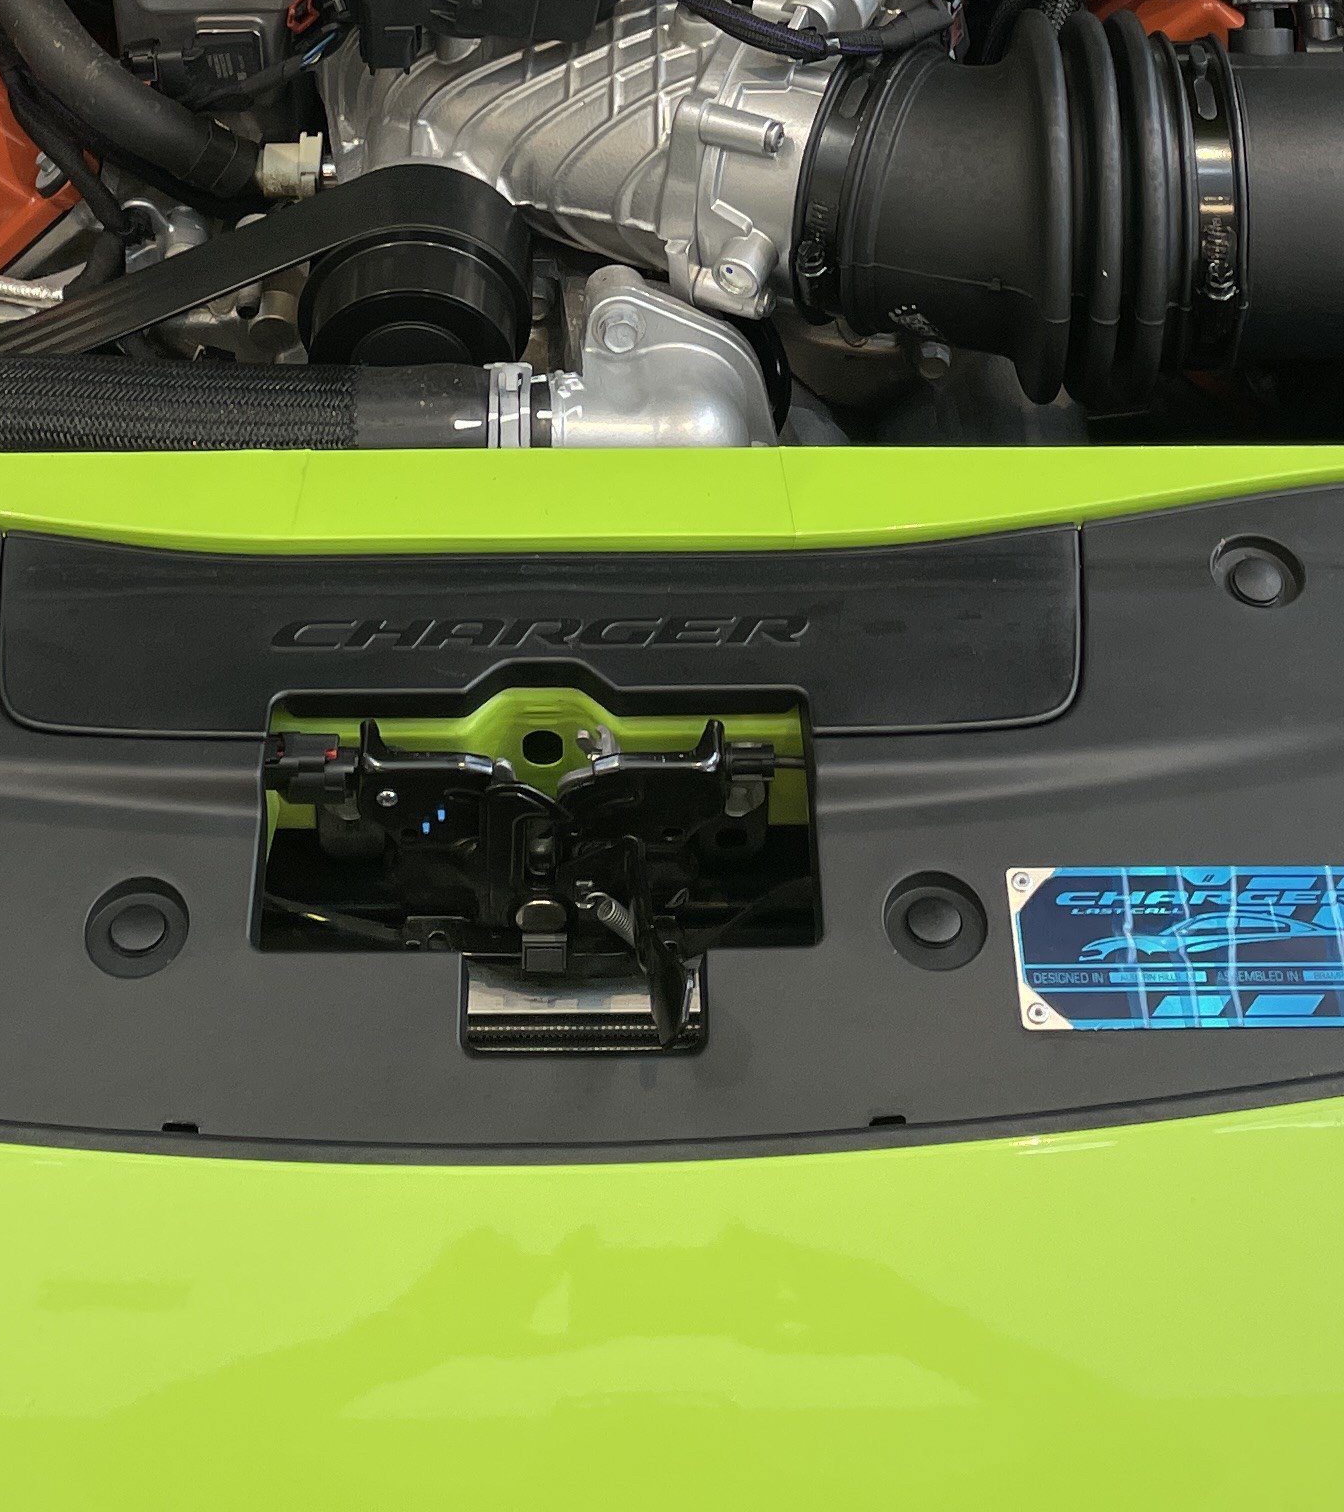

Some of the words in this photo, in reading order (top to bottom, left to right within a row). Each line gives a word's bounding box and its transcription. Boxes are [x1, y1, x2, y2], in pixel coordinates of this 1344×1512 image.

[270, 614, 811, 653] CHARGER
[1034, 972, 1088, 985] DESIGNED
[1092, 972, 1105, 984] IN
[1216, 971, 1280, 983] ASEMBLED
[1285, 971, 1299, 983] IN
